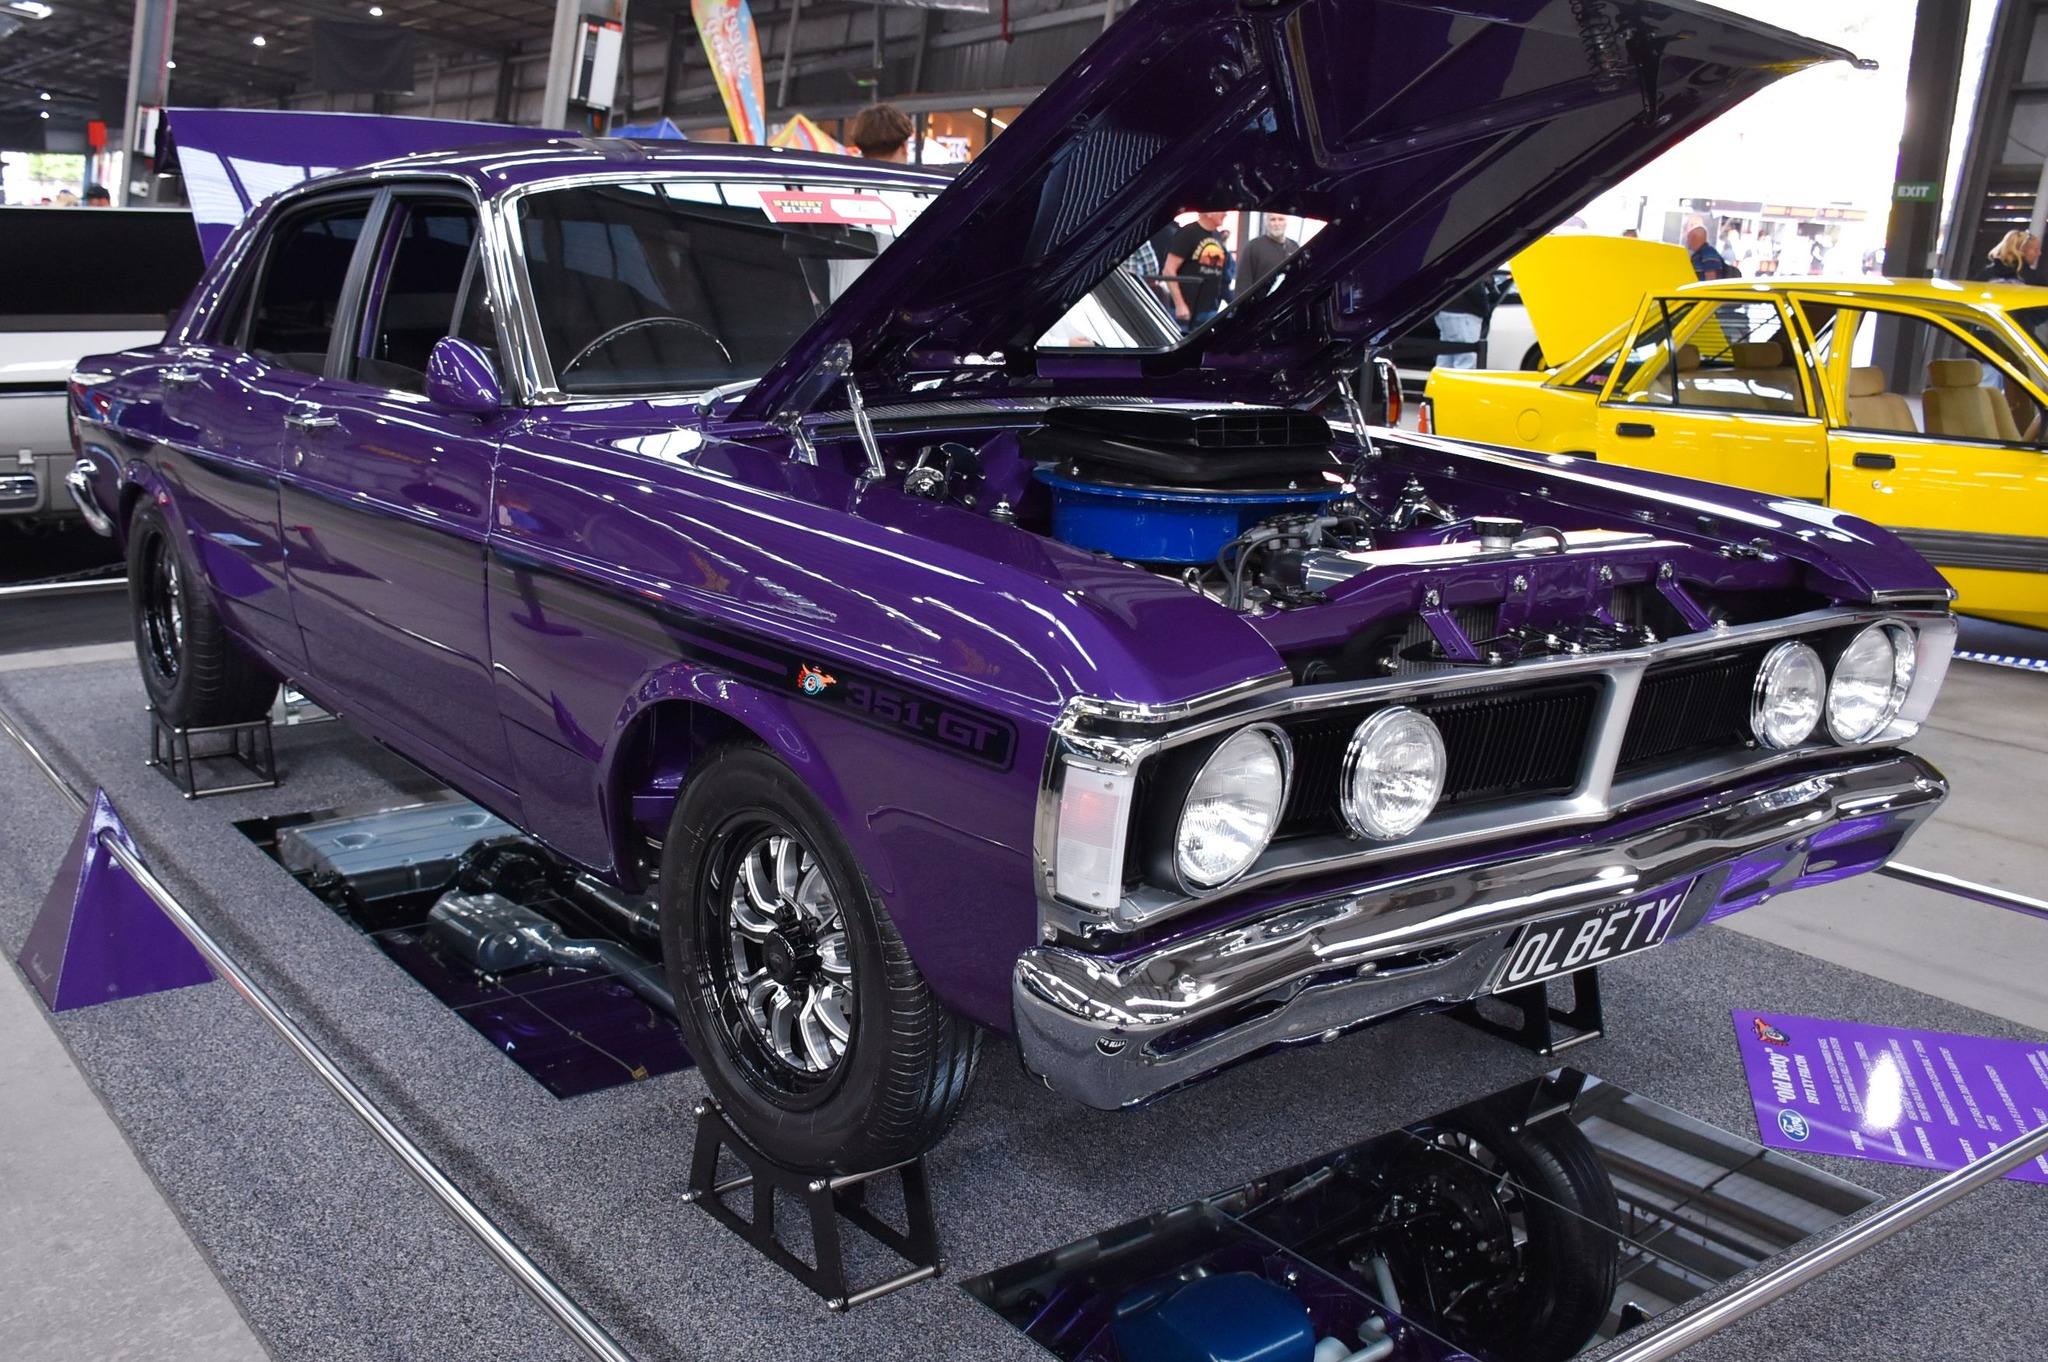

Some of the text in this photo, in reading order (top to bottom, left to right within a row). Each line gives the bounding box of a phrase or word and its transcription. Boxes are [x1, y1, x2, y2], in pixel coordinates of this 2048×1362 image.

[773, 200, 823, 208] STREET
[1897, 186, 1929, 198] EXIT
[845, 680, 998, 752] 351-GT
[1508, 894, 1681, 982] OLBETY
[1794, 1054, 1812, 1081] FALCON
[1783, 1115, 1809, 1142] Ford
